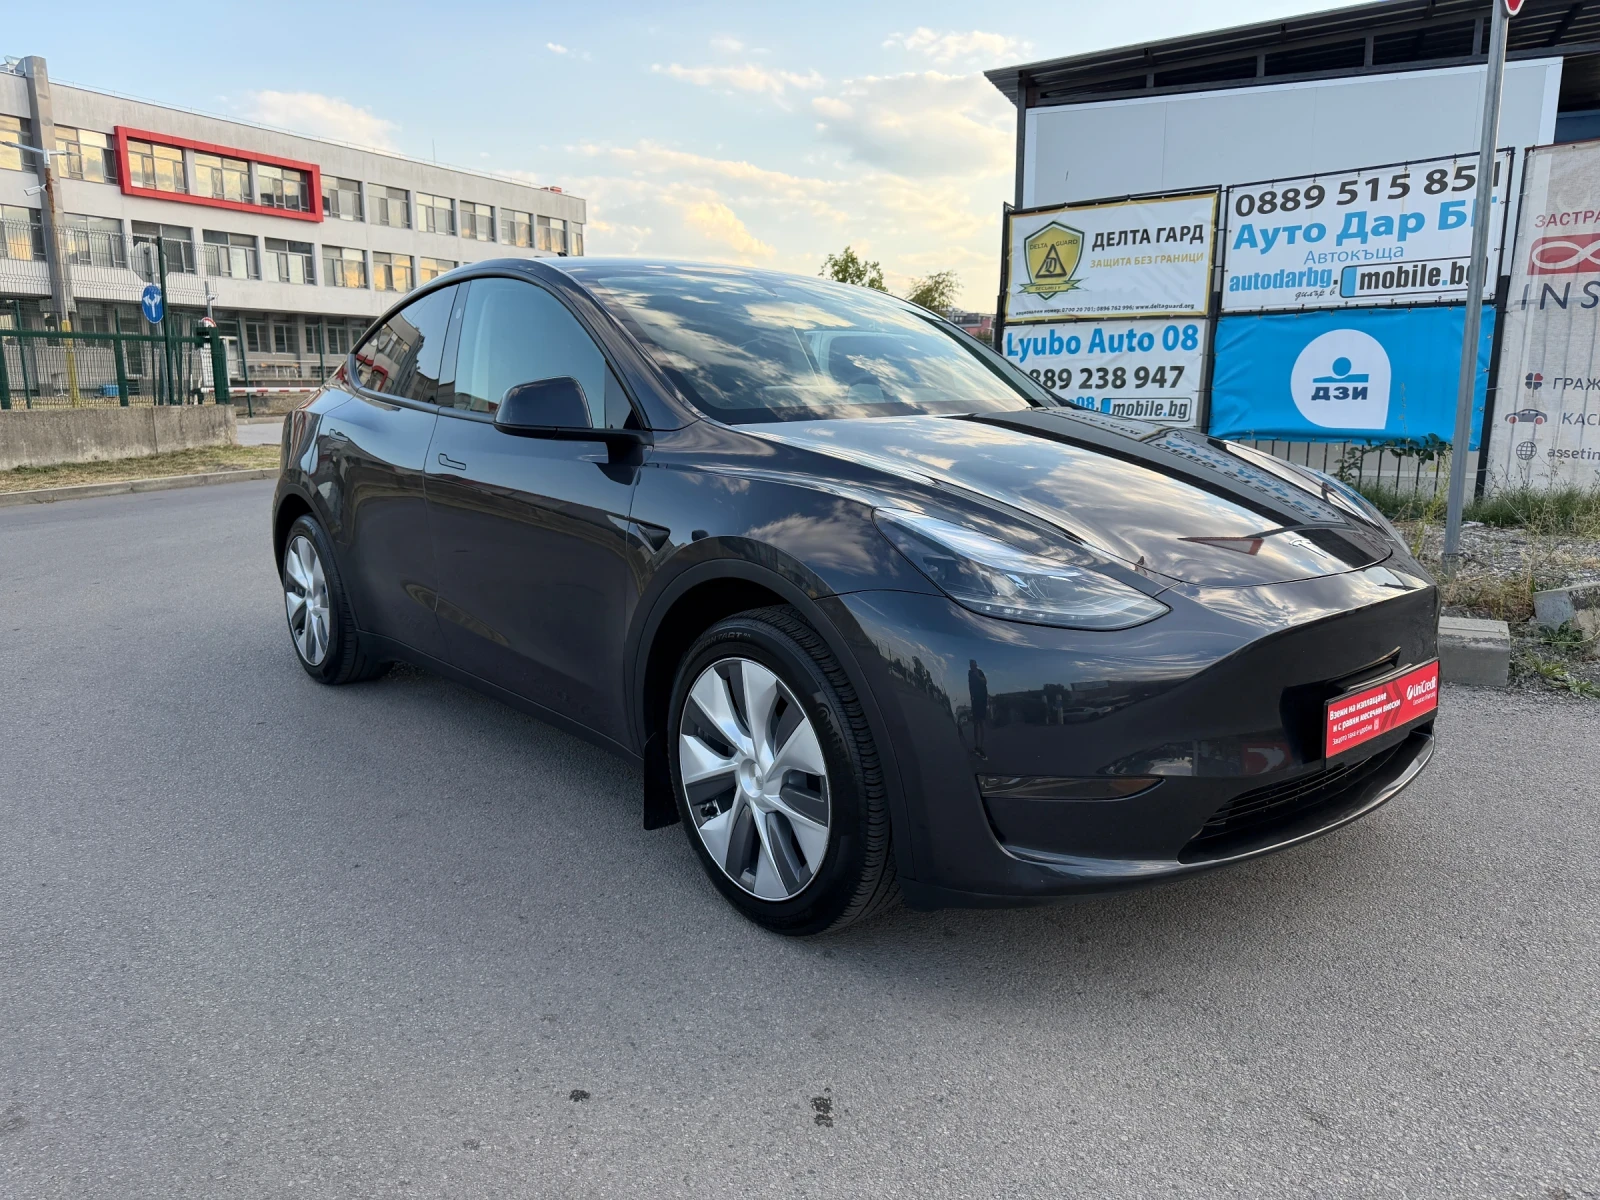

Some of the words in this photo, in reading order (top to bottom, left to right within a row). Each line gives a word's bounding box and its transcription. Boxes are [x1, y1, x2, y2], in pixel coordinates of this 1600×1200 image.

[1235, 184, 1326, 217] 0889
[1336, 173, 1411, 206] 515
[1055, 239, 1078, 247] GUARD
[1091, 228, 1151, 252] ДЕЛТА
[1155, 224, 1204, 245] ГАРД
[1233, 222, 1327, 255] Ауто
[1336, 211, 1425, 247] Дар
[1090, 257, 1132, 269] ЗАЩИТА
[1134, 255, 1153, 266] БЕЗ
[1155, 252, 1204, 264] ГРАНИЦИ
[1303, 246, 1404, 265] Автокъща
[1006, 328, 1081, 364] Lyubo
[1087, 327, 1155, 354] Auto
[1162, 324, 1199, 351] 08
[1078, 366, 1127, 390] 238
[1134, 365, 1186, 389] 947
[1310, 386, 1369, 401] ДЗИ
[1111, 400, 1189, 420] mobile.bg
[1413, 676, 1436, 696] UniCredit
[1329, 706, 1349, 721] Вземи
[1348, 704, 1357, 714] на
[1356, 692, 1387, 711] изплащане
